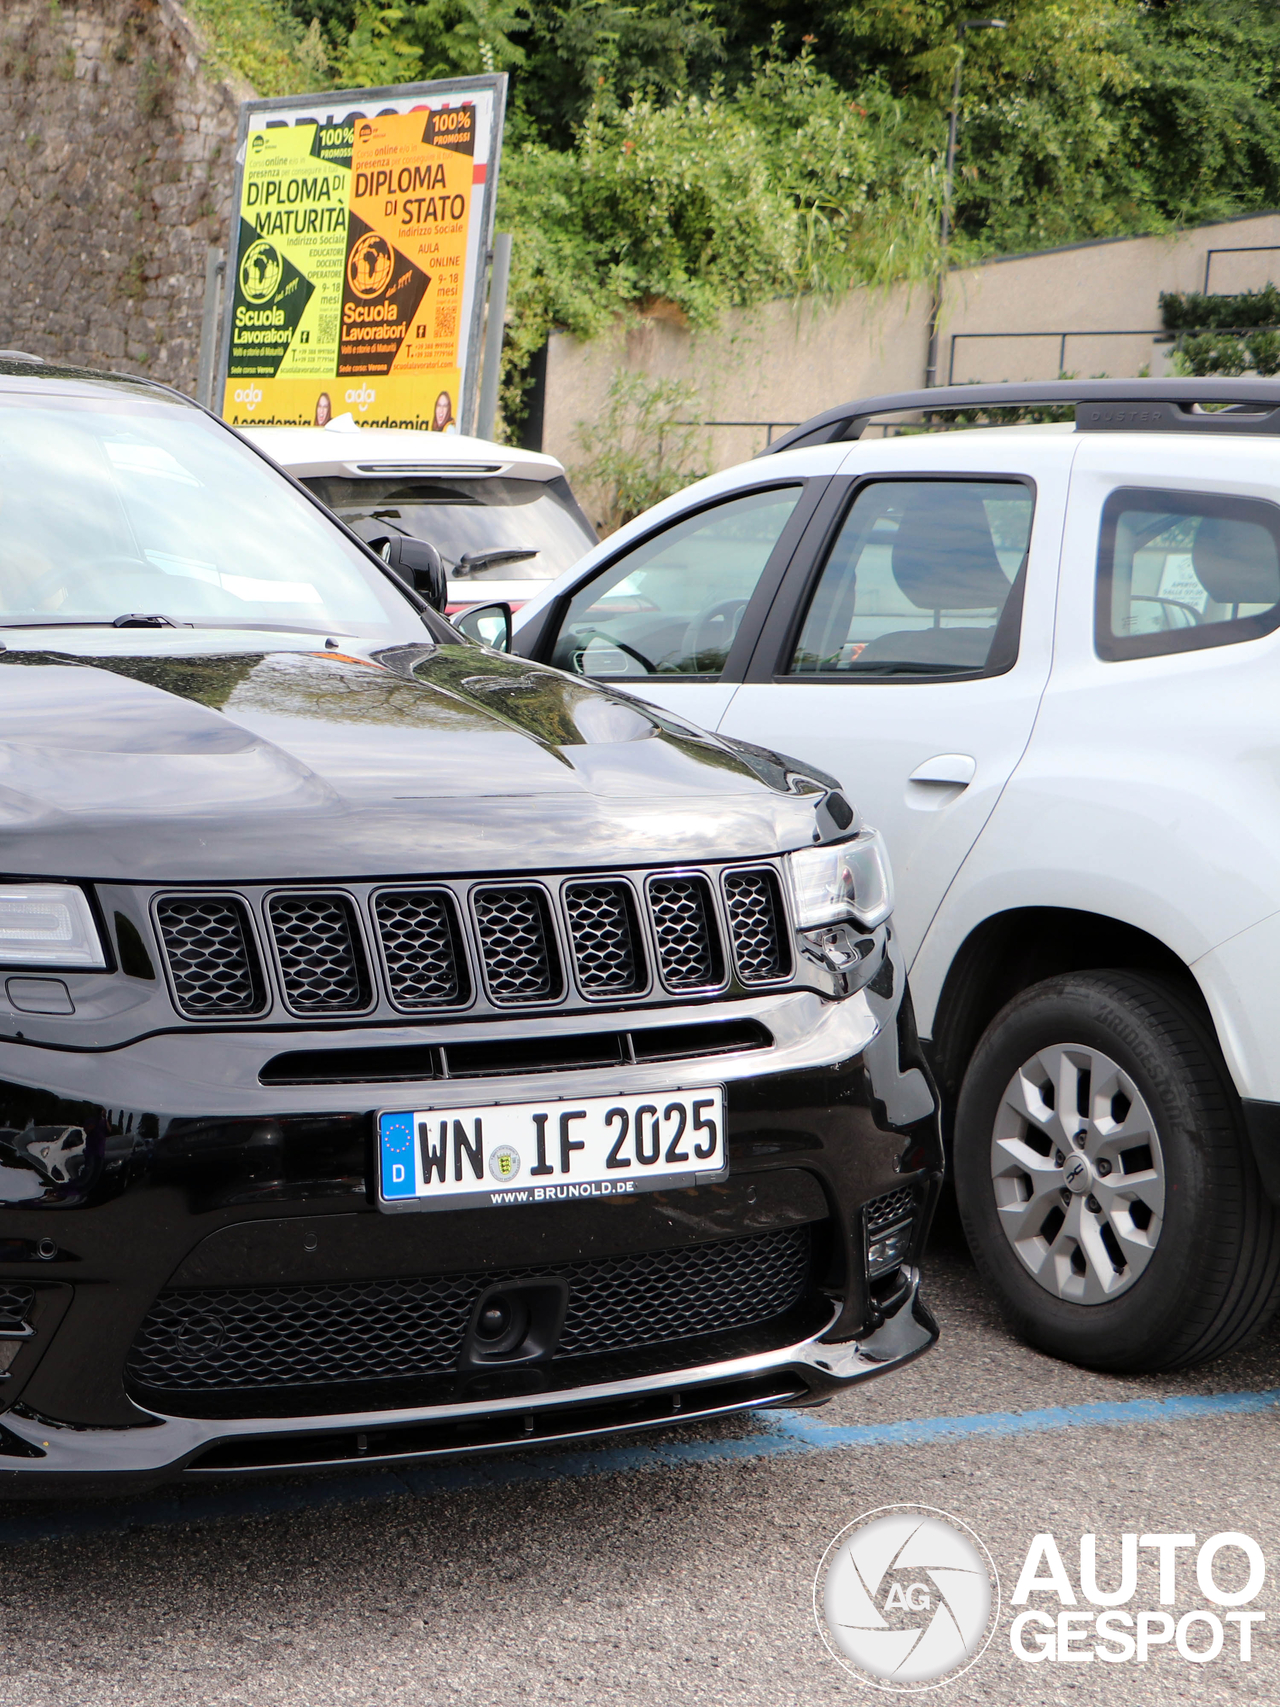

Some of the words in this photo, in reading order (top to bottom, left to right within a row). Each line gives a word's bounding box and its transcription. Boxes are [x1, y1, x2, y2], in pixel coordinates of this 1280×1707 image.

[432, 111, 471, 132] 100%
[320, 127, 354, 147] 100%
[433, 132, 471, 145] PROMOSSI
[357, 150, 374, 159] Corso
[374, 145, 398, 156] online
[265, 156, 288, 166] online
[356, 158, 390, 172] presenza
[391, 158, 402, 168] per
[402, 155, 435, 166] conseguire
[442, 152, 454, 160] tuo
[248, 169, 280, 180] presenza
[355, 164, 446, 198] DIPLOMA
[247, 177, 331, 206] DIPLOMA
[332, 175, 345, 191] DI
[385, 200, 398, 216] DI
[401, 194, 465, 225] STATO
[256, 198, 346, 236] MATURITÀ
[398, 226, 432, 238] Indirizzo
[434, 223, 463, 234] Sociale
[287, 236, 317, 246] Indirizzo
[320, 234, 345, 244] Sociale
[309, 248, 344, 257] EDUCATORE
[418, 243, 440, 254] AULA
[316, 259, 343, 268] DOCENTE
[429, 256, 460, 268] ONLINE
[308, 270, 342, 278] OPERATORE
[437, 284, 458, 297] mesi
[320, 294, 340, 304] mesi
[235, 305, 285, 327] Scuola
[343, 300, 398, 324] Scuola
[233, 326, 292, 344] Lavoratori
[342, 321, 406, 342] Lavoratori
[406, 344, 414, 358] T.
[257, 366, 274, 374] Verona
[393, 361, 453, 370] scuolalavoratori.com
[1090, 411, 1162, 422] DUSTER
[419, 1117, 484, 1185] WN
[530, 1110, 587, 1177] IF
[606, 1098, 718, 1170] 2025
[392, 1164, 405, 1183] D
